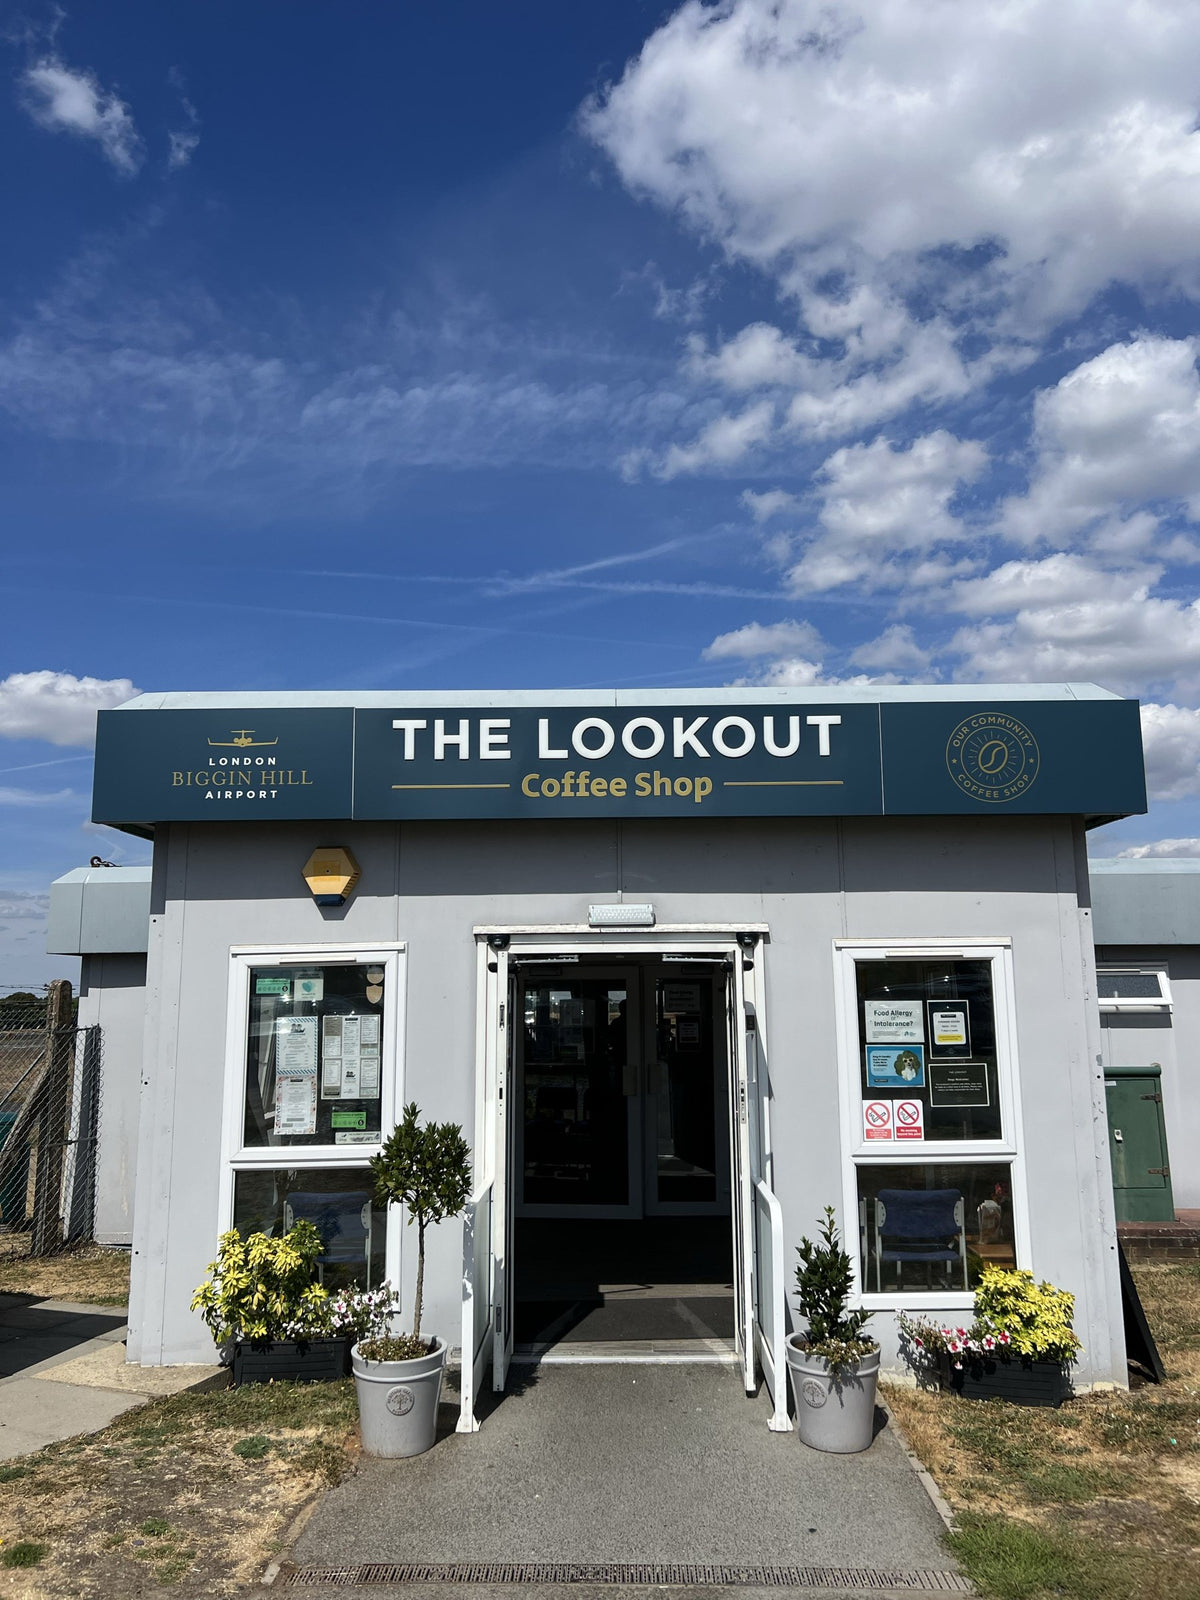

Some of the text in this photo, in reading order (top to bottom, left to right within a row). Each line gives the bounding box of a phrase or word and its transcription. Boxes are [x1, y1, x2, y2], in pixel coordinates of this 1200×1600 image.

[391, 715, 842, 761] THE LOOKOUT
[953, 717, 1033, 747] OUR COMMUNITY
[208, 757, 277, 766] LONDON
[171, 770, 313, 786] BIGGIN HILL
[521, 770, 713, 803] Coffee Shop
[958, 774, 1029, 798] COFFEE SHOP
[205, 790, 278, 799] AIRPORT
[890, 1009, 913, 1017] Allergy
